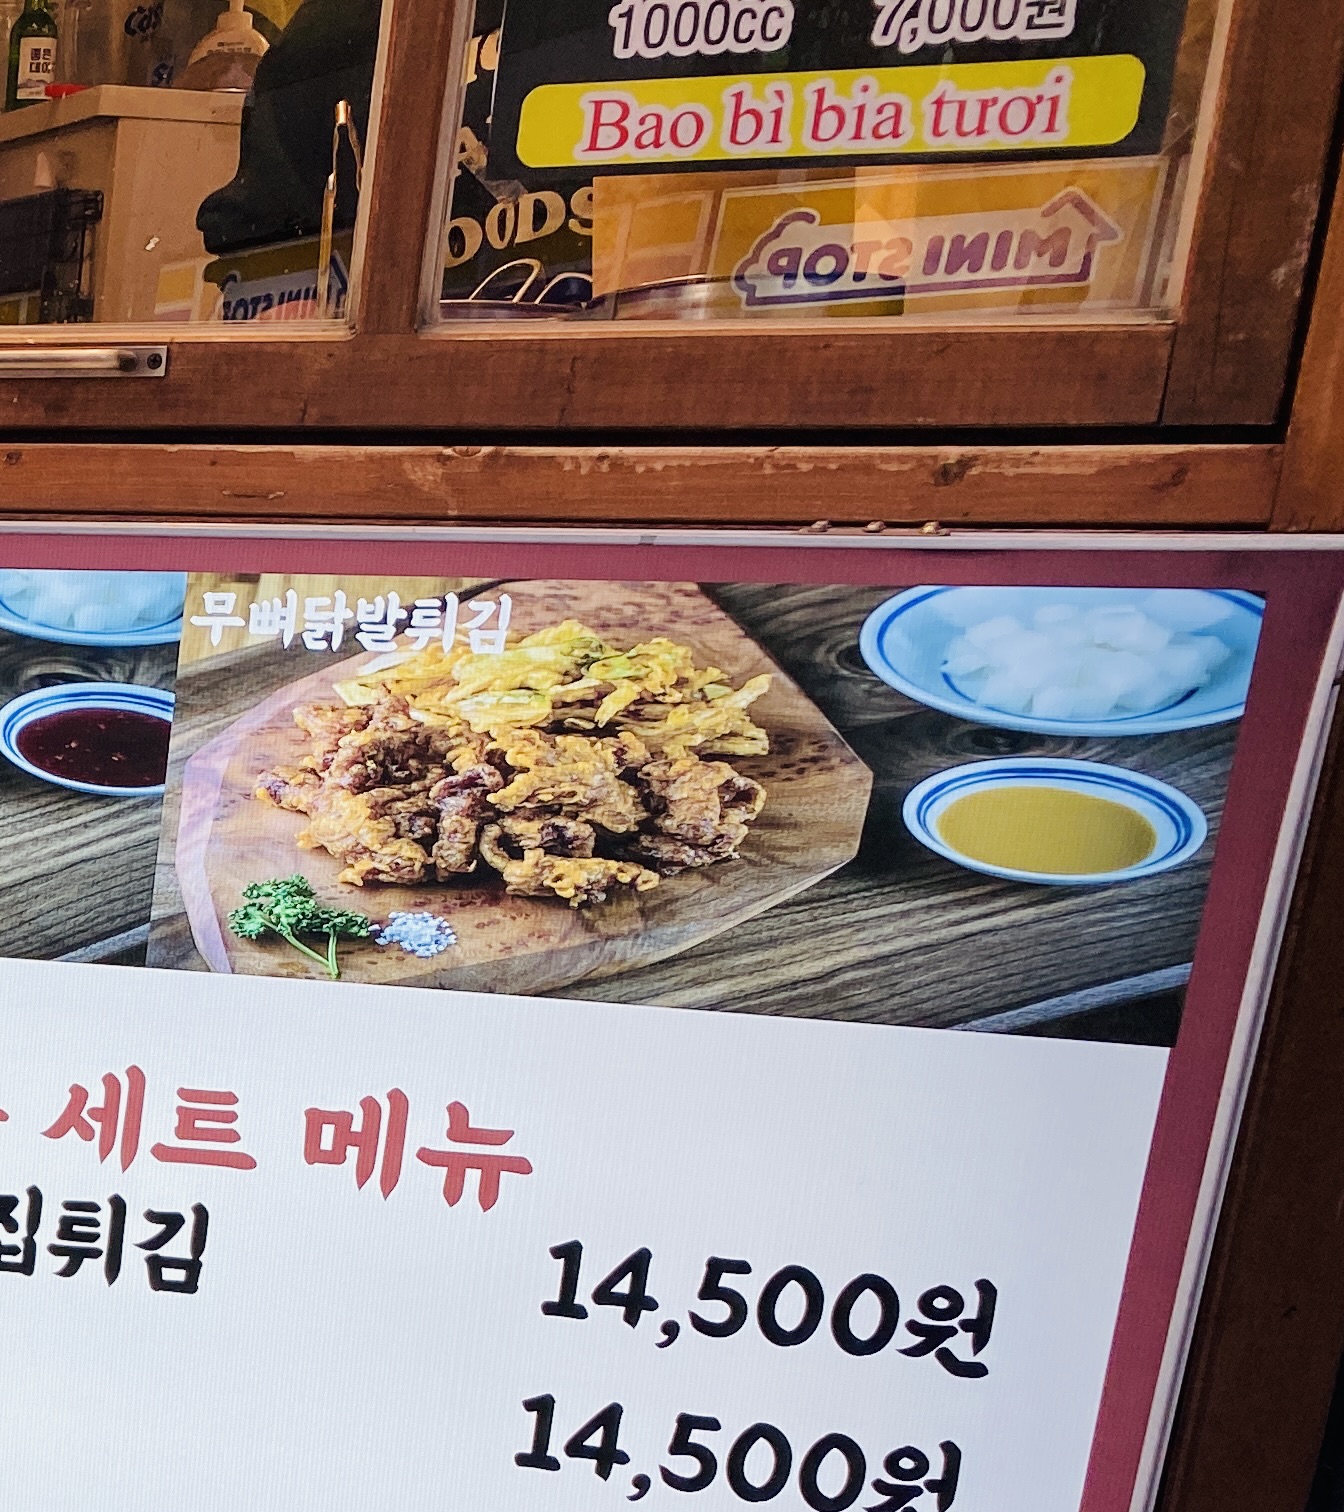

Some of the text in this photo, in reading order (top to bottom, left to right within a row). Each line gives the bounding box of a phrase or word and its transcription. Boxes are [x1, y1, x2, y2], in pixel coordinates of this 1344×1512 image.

[614, 2, 787, 50] 1000cc
[582, 74, 1067, 153] Bao bì bia tươi
[189, 588, 513, 655] 무뼈닭발튀김
[40, 1064, 258, 1172] 세트
[303, 1087, 534, 1213] 메뉴
[541, 1239, 999, 1379] 14,500원
